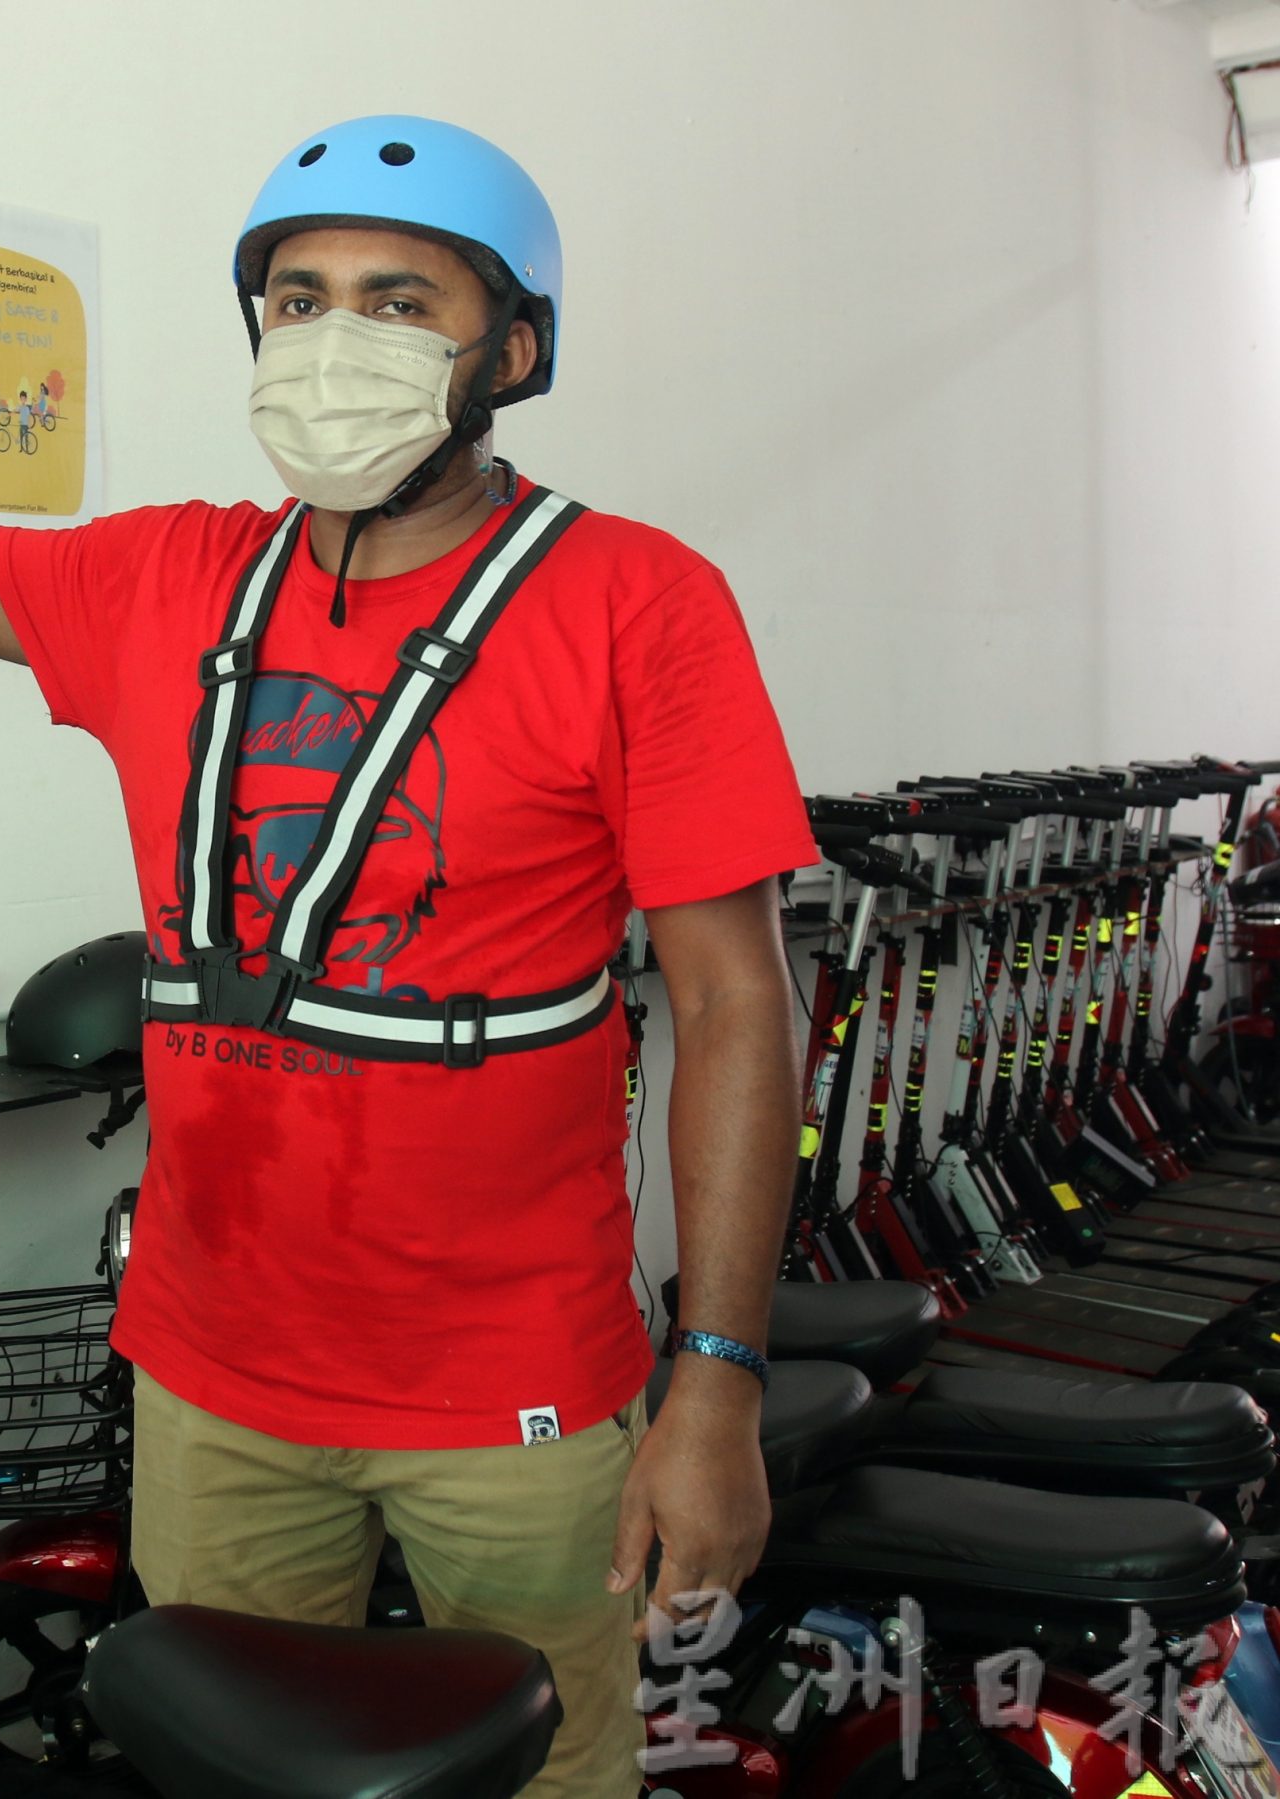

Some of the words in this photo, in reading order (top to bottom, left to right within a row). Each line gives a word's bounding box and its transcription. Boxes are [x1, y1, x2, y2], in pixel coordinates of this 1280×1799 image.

[5, 266, 49, 282] Berbasikal
[166, 1025, 188, 1057] by
[191, 1031, 207, 1057] B
[214, 1037, 272, 1070] ONE
[280, 1046, 364, 1076] SOUL
